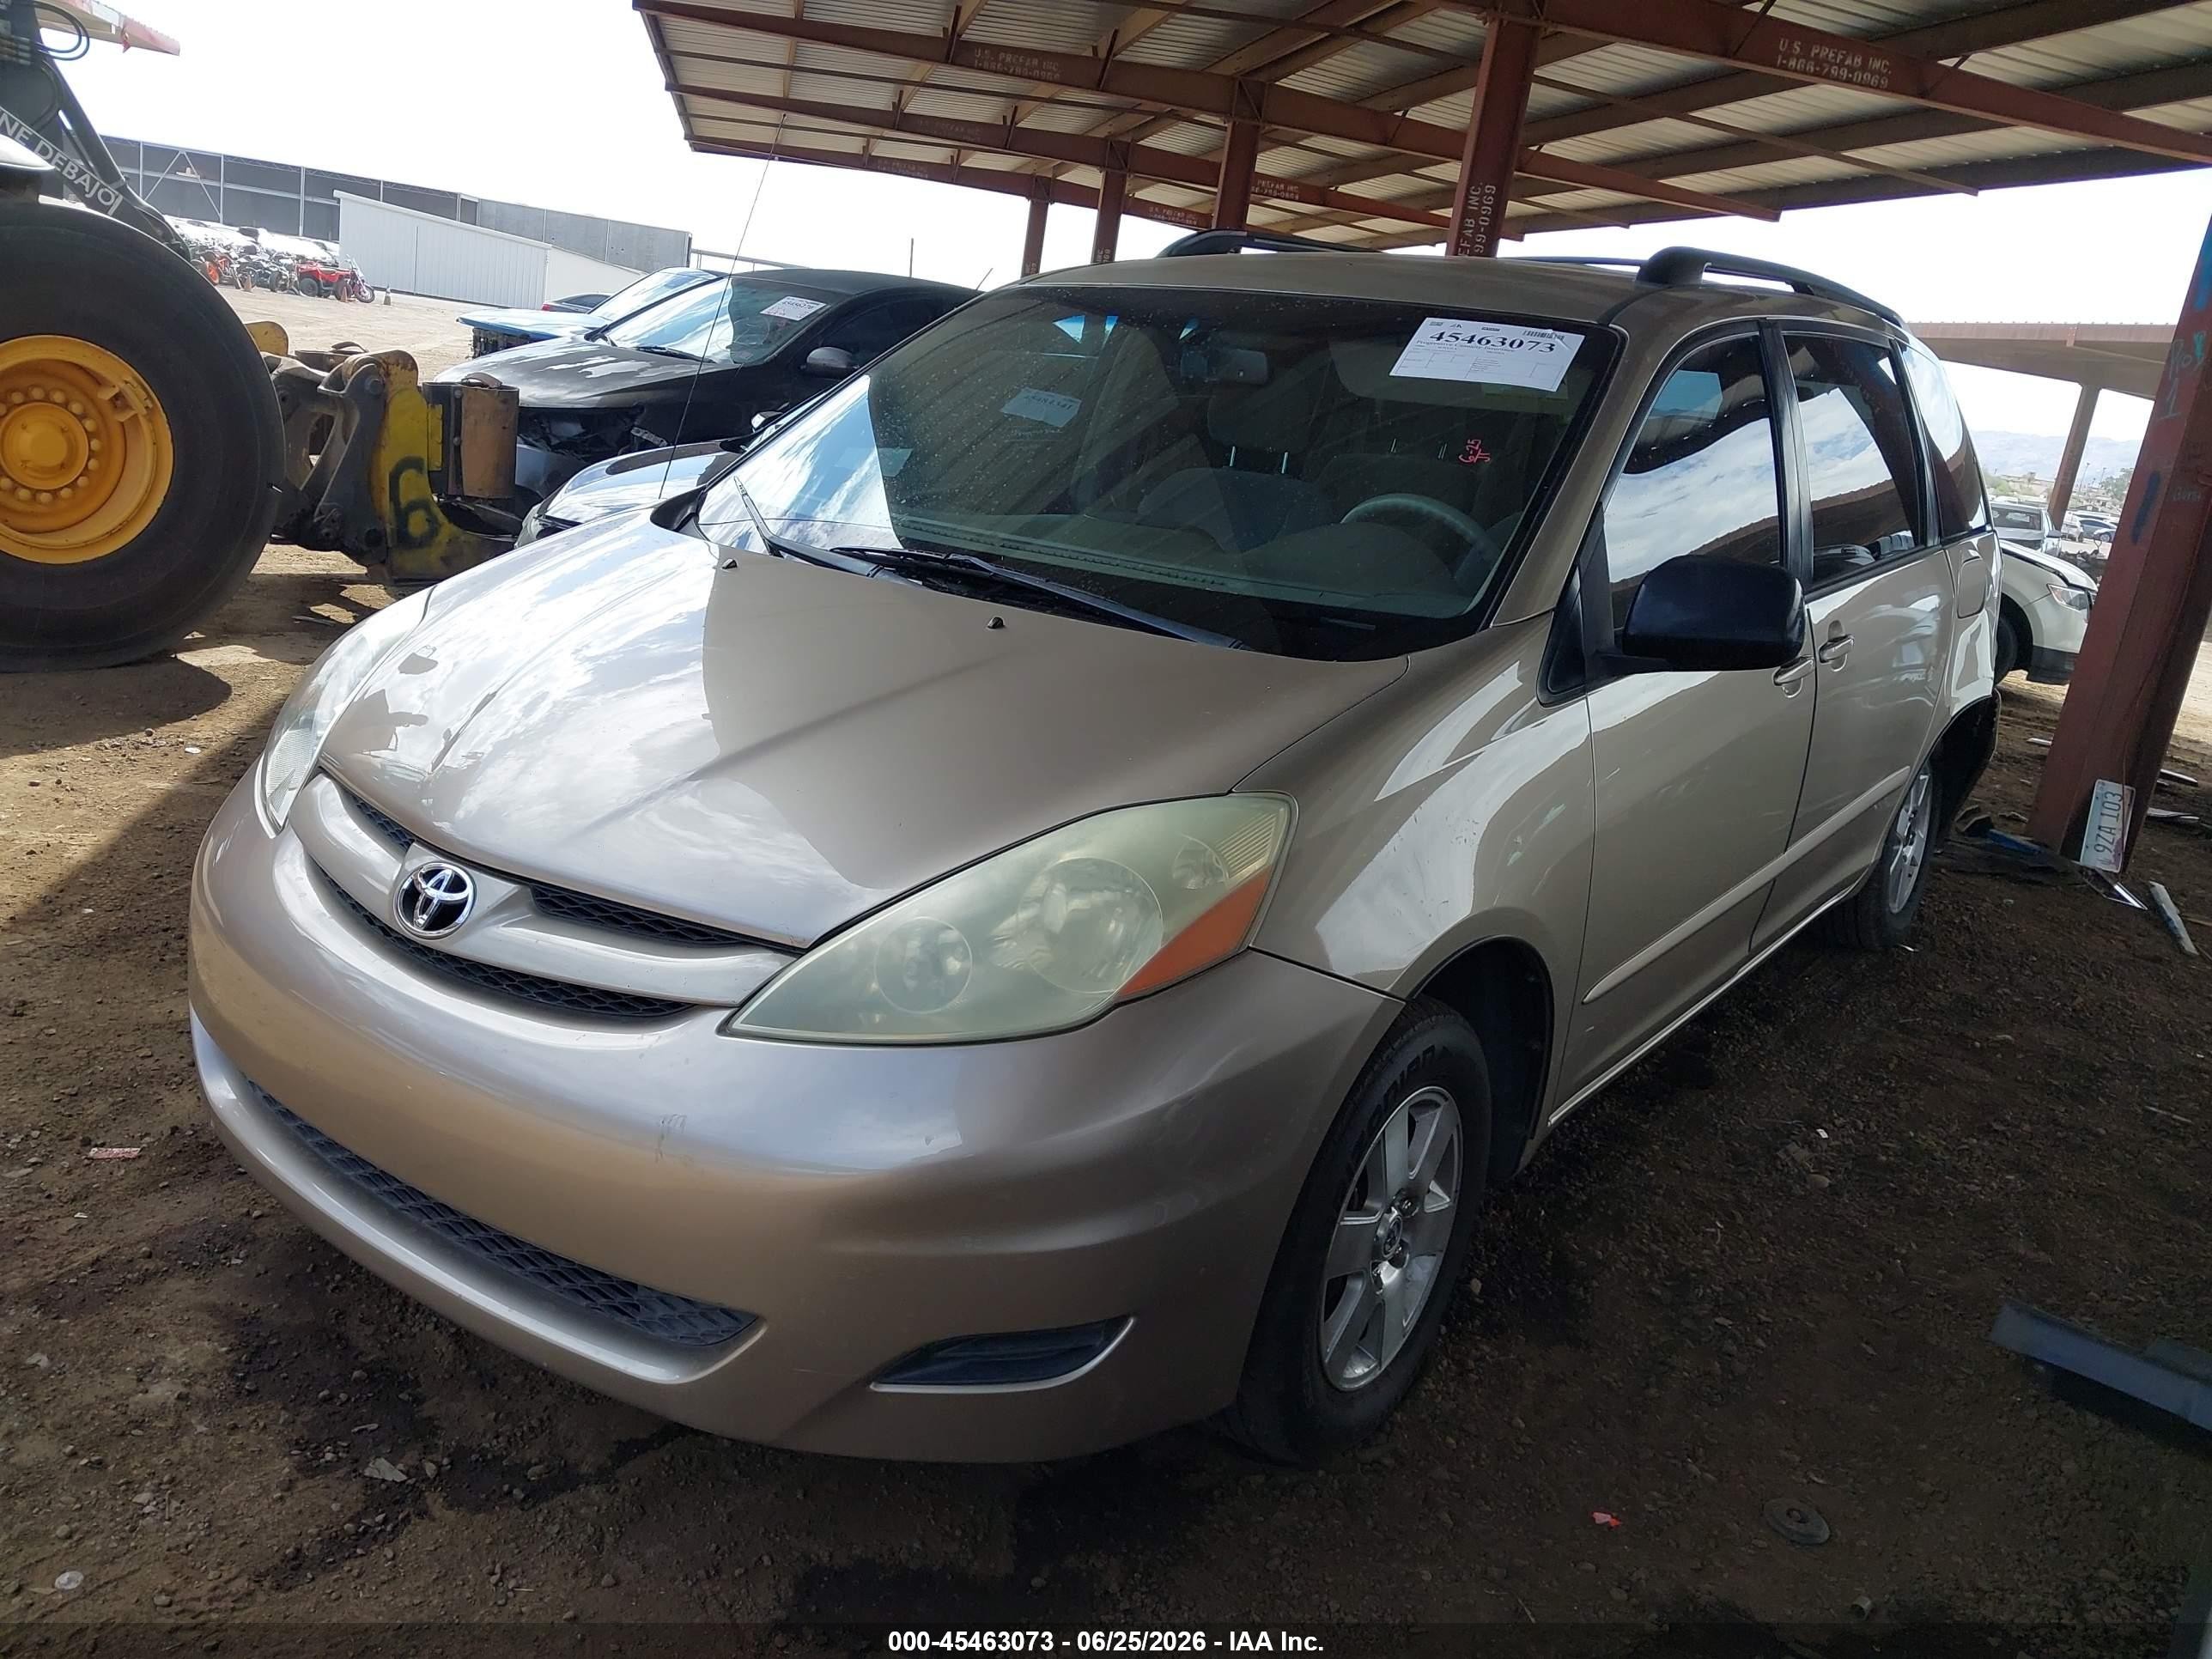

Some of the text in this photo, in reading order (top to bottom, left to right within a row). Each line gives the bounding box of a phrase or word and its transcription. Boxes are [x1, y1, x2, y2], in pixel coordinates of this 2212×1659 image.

[1811, 45, 1862, 68] PREFAB
[1868, 57, 1893, 75] INC.
[33, 139, 116, 206] DEBAJO
[1429, 330, 1556, 354] 45463073
[388, 455, 441, 550] 6
